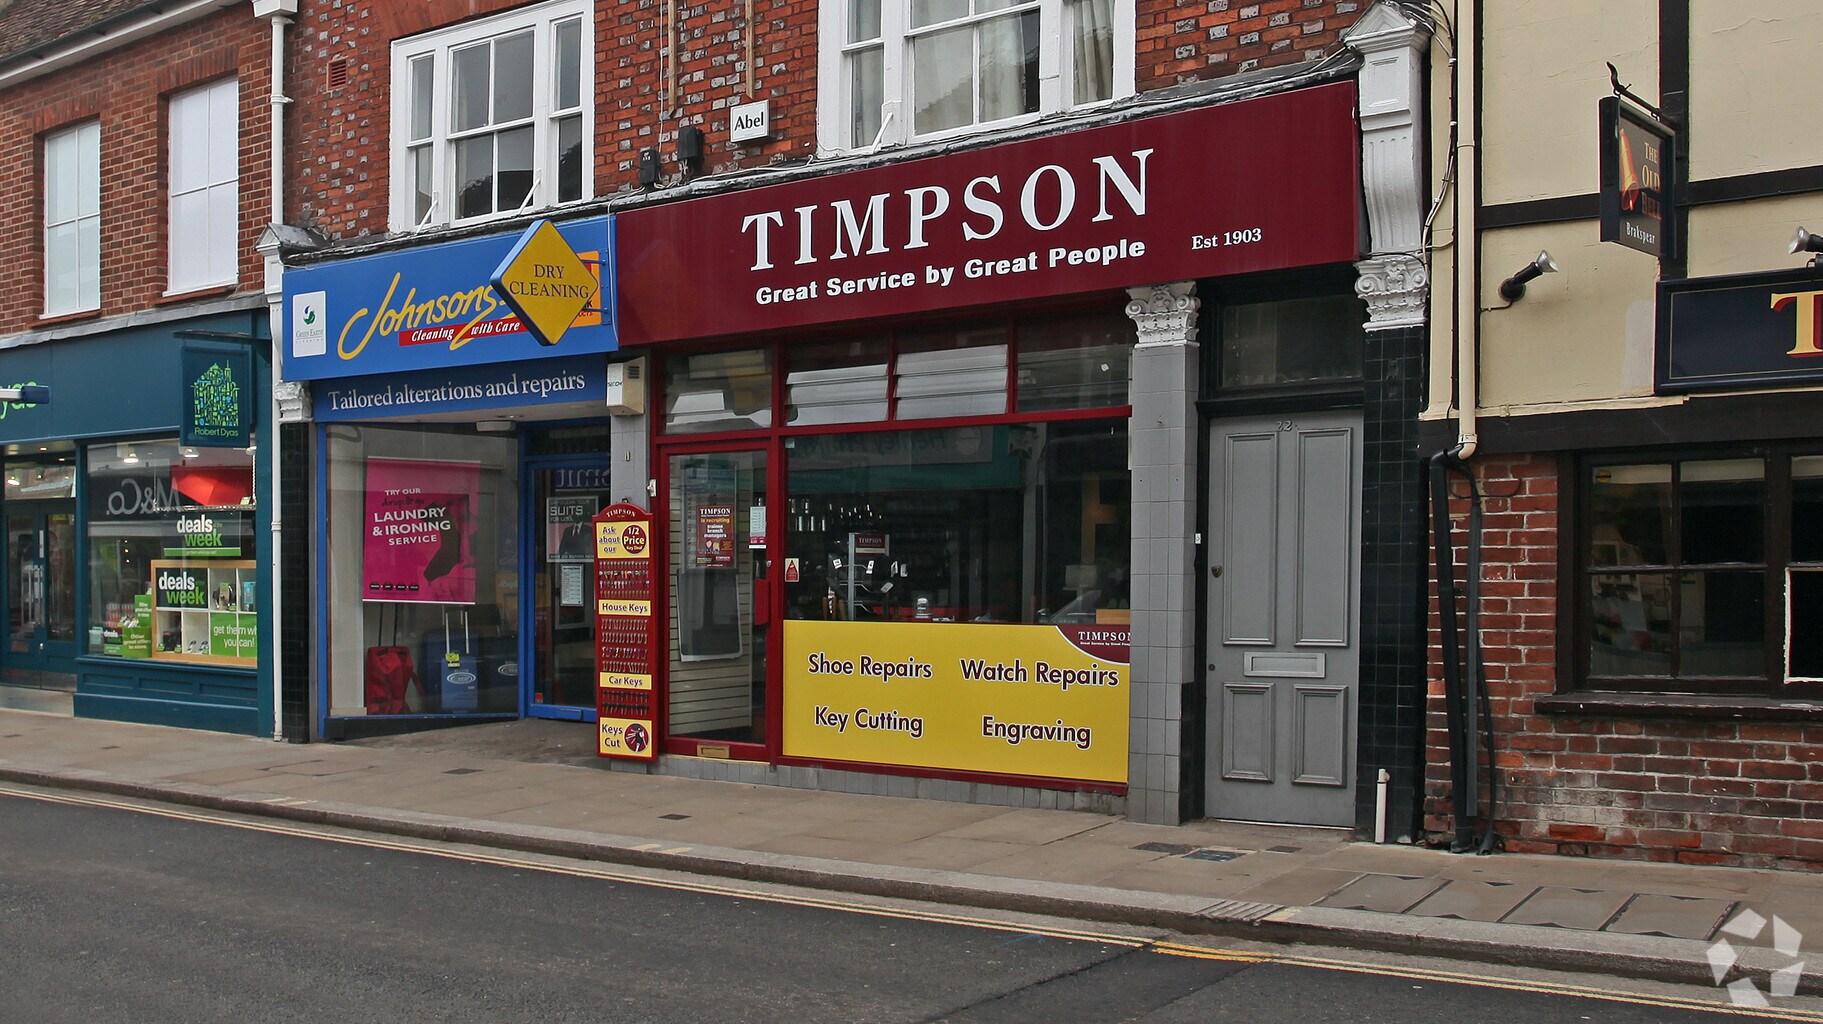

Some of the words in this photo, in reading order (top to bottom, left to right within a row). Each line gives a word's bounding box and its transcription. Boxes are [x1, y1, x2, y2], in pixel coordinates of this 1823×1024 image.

[734, 111, 765, 130] Abel
[1644, 141, 1658, 164] THE
[741, 148, 1155, 272] TIMPSON
[1190, 233, 1218, 251] Est
[1222, 227, 1262, 246] 1903
[1626, 221, 1656, 245] Brakspear
[534, 263, 564, 279] DRY
[756, 282, 818, 306] Great
[826, 269, 916, 299] Service
[926, 265, 955, 287] by
[965, 253, 1038, 278] Great
[1049, 238, 1146, 269] People
[509, 280, 589, 300] CLEANING
[337, 272, 505, 360] Johnsons
[411, 327, 454, 342] Cleaning
[470, 322, 494, 336] with
[495, 320, 520, 334] Care
[328, 384, 393, 411] Tailored
[396, 379, 482, 404] alterations
[486, 373, 519, 397] and
[521, 369, 585, 396] repairs
[194, 427, 220, 436] Robert
[221, 428, 239, 437] Dyas
[1276, 420, 1293, 432] 22
[402, 487, 421, 495] OUR
[374, 507, 446, 523] LAUNDRY
[550, 505, 583, 516] SUITS
[606, 508, 636, 517] TIMPSON
[700, 507, 731, 515] TIMPSON
[177, 514, 213, 533] deals
[372, 526, 382, 536] &
[385, 520, 451, 535] IRONING
[602, 526, 616, 535] Ask
[627, 527, 640, 535] 1/2
[184, 528, 222, 547] week
[388, 534, 437, 546] SERVICE
[599, 536, 620, 544] about
[623, 535, 645, 545] Price
[158, 571, 195, 590] deals
[166, 586, 205, 605] week
[602, 602, 628, 611] House
[629, 603, 648, 613] Keys
[213, 625, 225, 636] get
[223, 637, 237, 649] you
[239, 635, 255, 647] can!
[808, 652, 854, 676] Shoe
[858, 654, 933, 683] Repairs
[960, 658, 1028, 684] Watch
[1035, 661, 1120, 691] Repairs
[608, 675, 622, 685] Car
[623, 676, 643, 686] Keys
[601, 723, 623, 736] Keys
[814, 705, 849, 733] Key
[854, 706, 924, 738] Cutting
[982, 715, 1093, 750] Engraving
[604, 737, 621, 748] Cut
